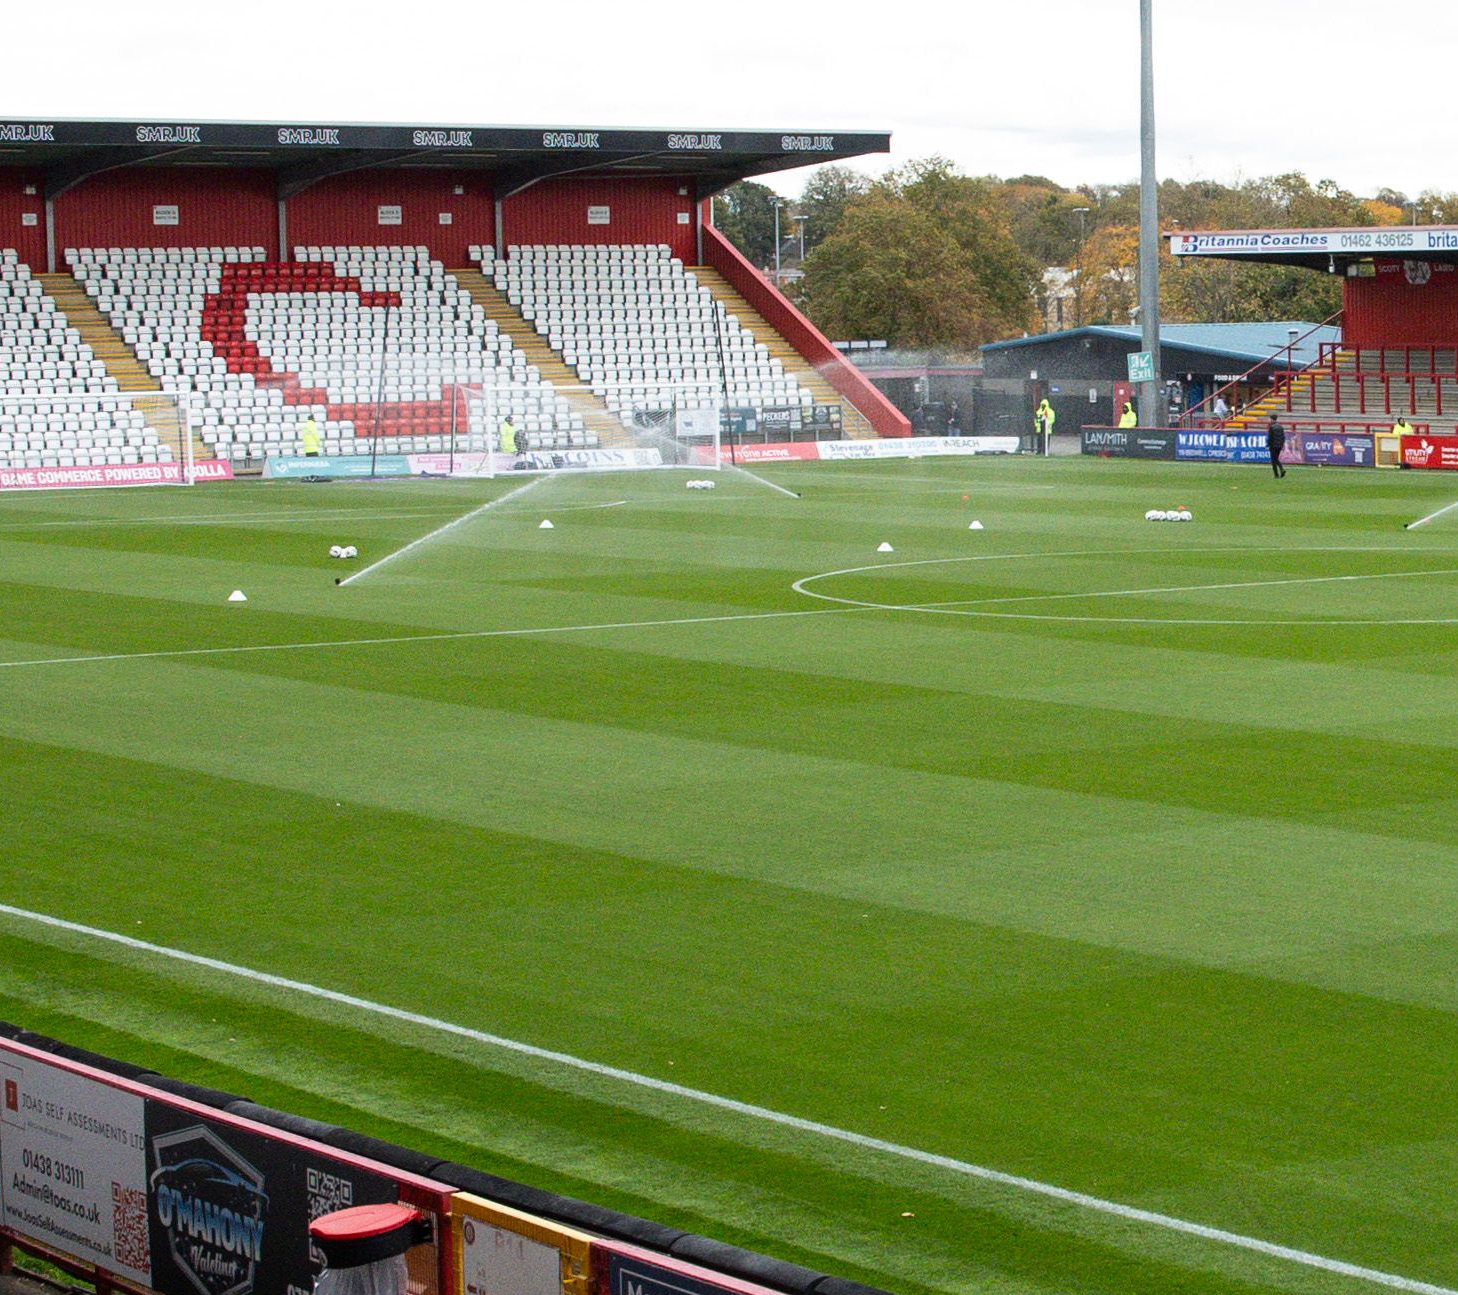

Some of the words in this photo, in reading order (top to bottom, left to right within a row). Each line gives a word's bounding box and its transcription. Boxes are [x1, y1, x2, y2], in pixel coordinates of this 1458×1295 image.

[278, 128, 339, 144] SMR.UK
[543, 132, 599, 148] SMR.UK
[782, 135, 833, 151] SMR.UK
[1130, 367, 1152, 380] Exit
[762, 411, 791, 421] PECKERS
[1, 473, 35, 487] GAME
[37, 469, 103, 485] COMMERCE
[105, 466, 162, 482] POWERED
[164, 465, 178, 479] BY
[22, 1147, 52, 1177] 01438
[54, 1159, 84, 1190] 313111
[157, 1183, 264, 1263] O'MAHONY
